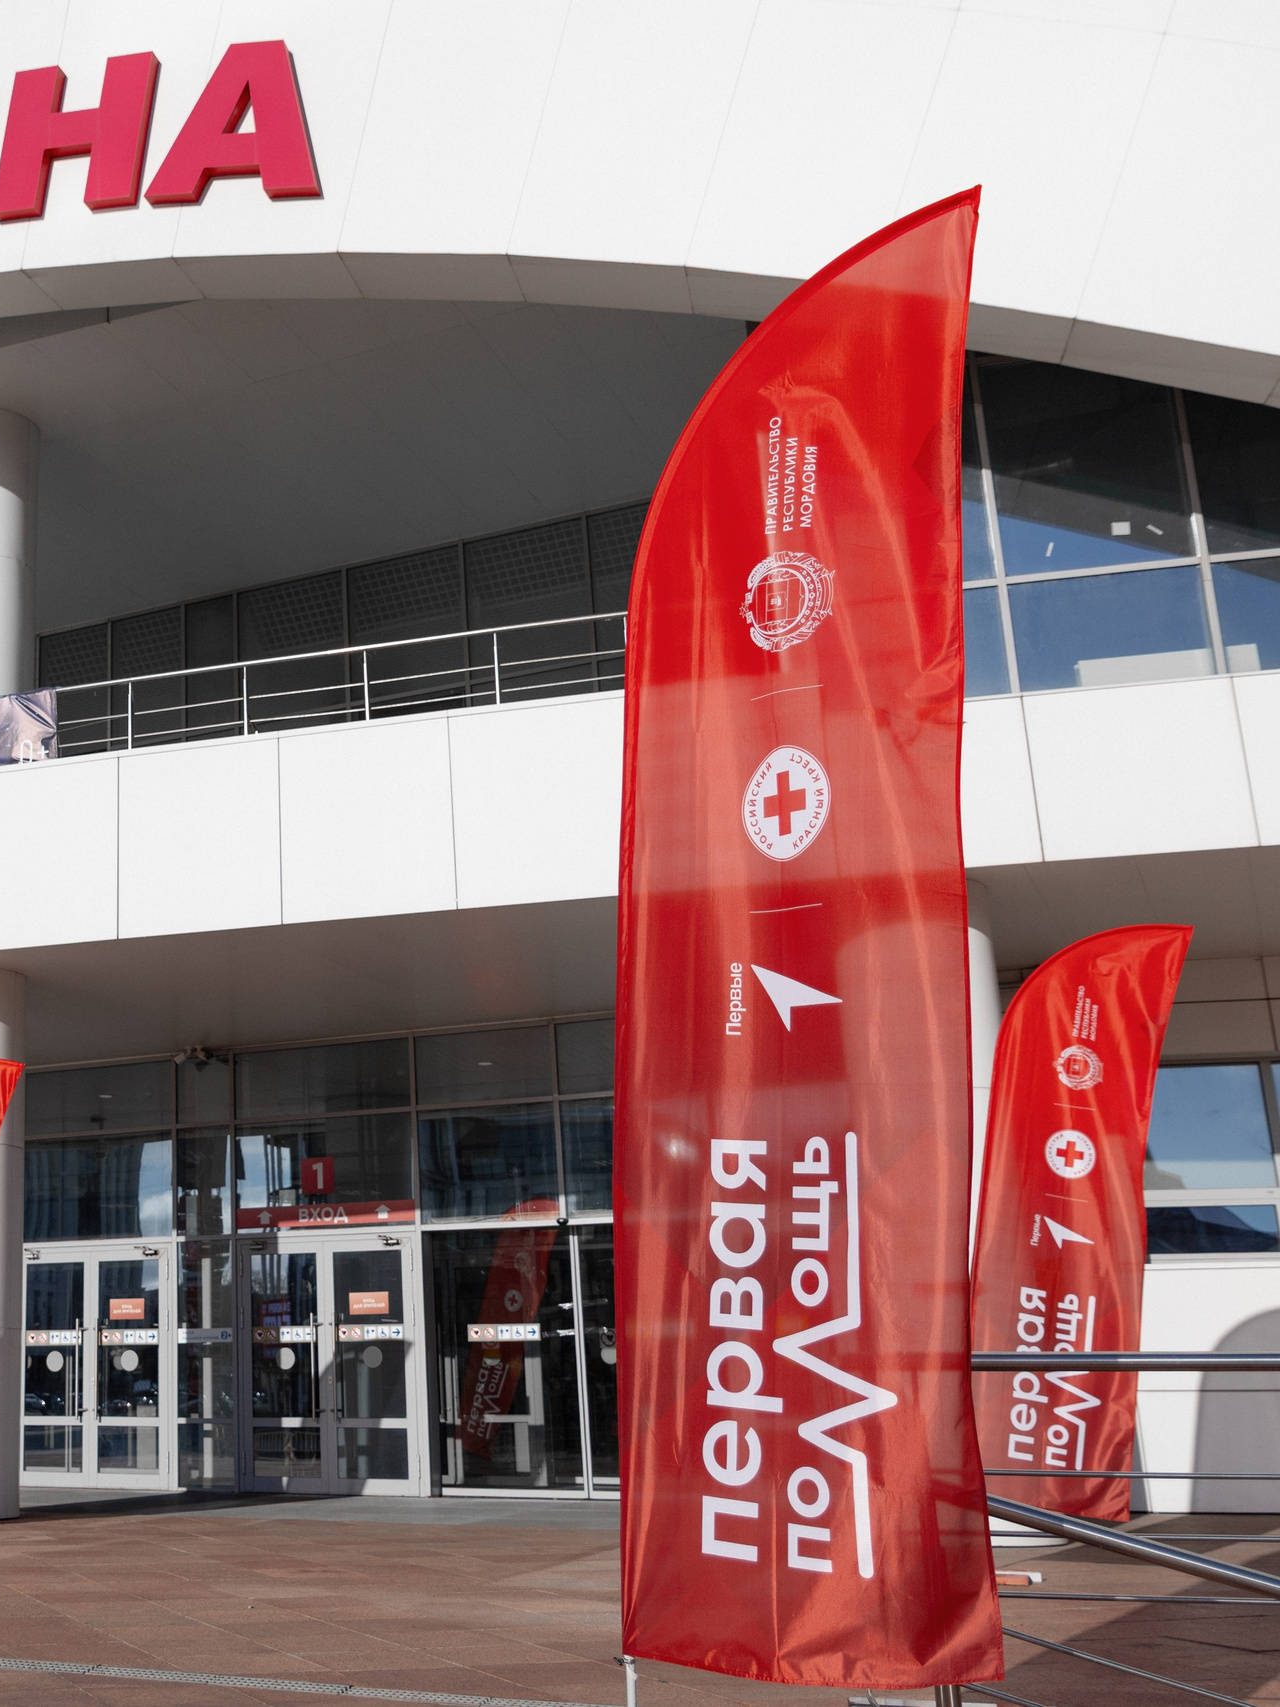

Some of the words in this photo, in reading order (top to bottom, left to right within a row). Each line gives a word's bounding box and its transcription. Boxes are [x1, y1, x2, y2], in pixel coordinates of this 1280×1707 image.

[765, 416, 782, 535] ПРАВИТЕЛЬСТВО
[783, 437, 798, 532] РЕСПУБЛИКИ
[800, 446, 817, 528] МОРДОВИЯ
[749, 761, 773, 851] РОССИЙСКИЙ
[789, 752, 822, 783] КРЕСТ
[792, 787, 825, 851] КРАСНЫЙ
[725, 962, 747, 1036] Первые
[298, 1206, 349, 1224] ВХОД
[312, 1162, 324, 1190] 1
[702, 1138, 783, 1562] первая
[772, 1131, 898, 1579] помощь
